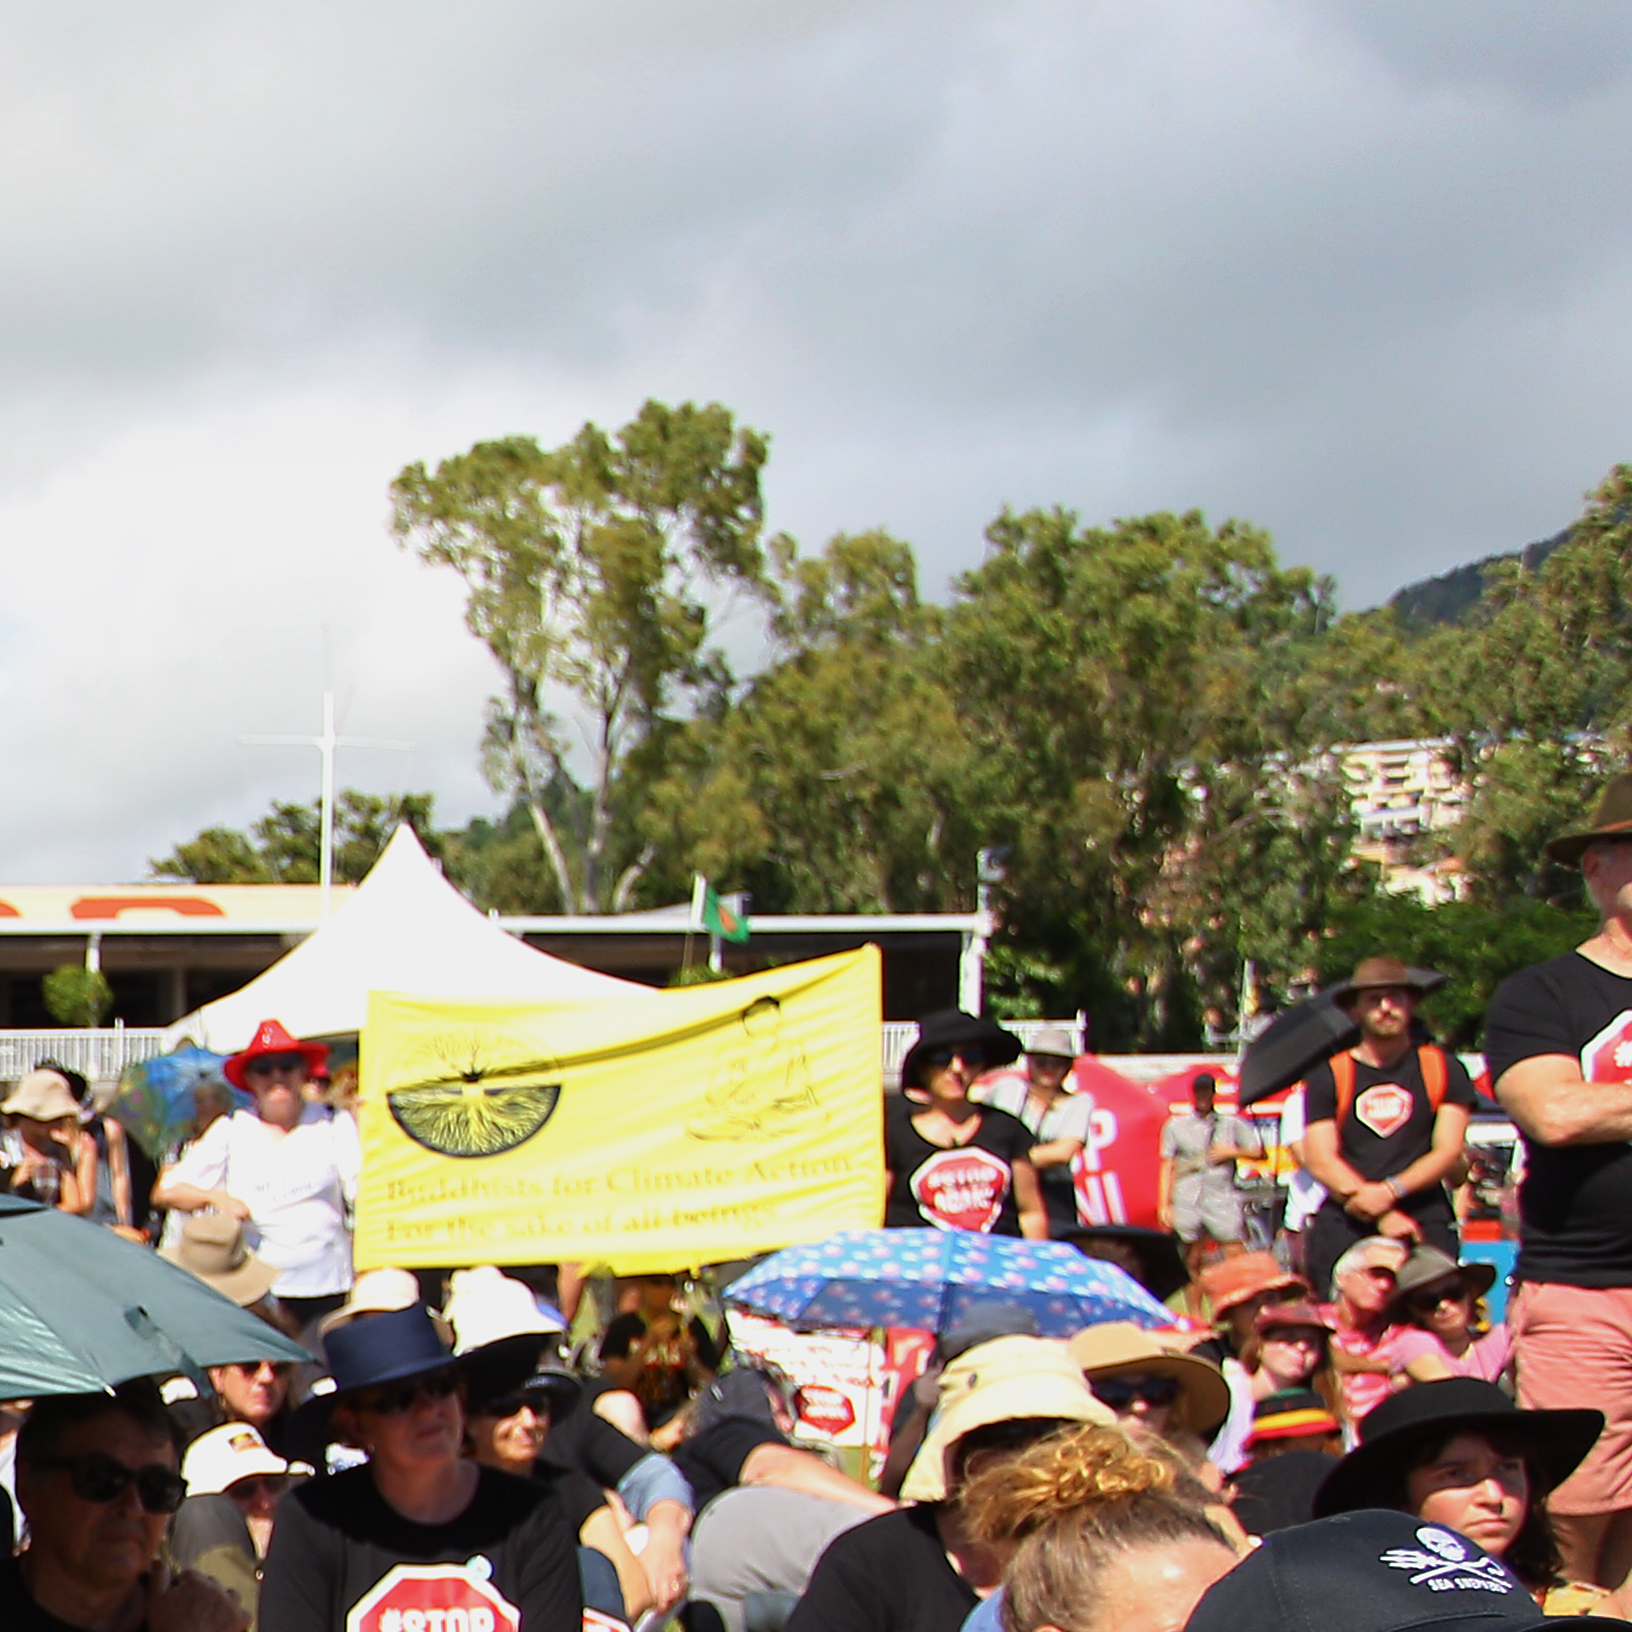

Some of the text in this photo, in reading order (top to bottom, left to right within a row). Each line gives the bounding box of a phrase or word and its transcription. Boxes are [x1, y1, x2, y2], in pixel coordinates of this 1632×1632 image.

[551, 1173, 599, 1196] for
[606, 1164, 735, 1194] Climate
[745, 1155, 853, 1184] Action
[386, 1220, 436, 1242] For
[446, 1215, 494, 1241] the
[506, 1212, 573, 1240] sake
[583, 1213, 613, 1234] of
[621, 1207, 662, 1232] all
